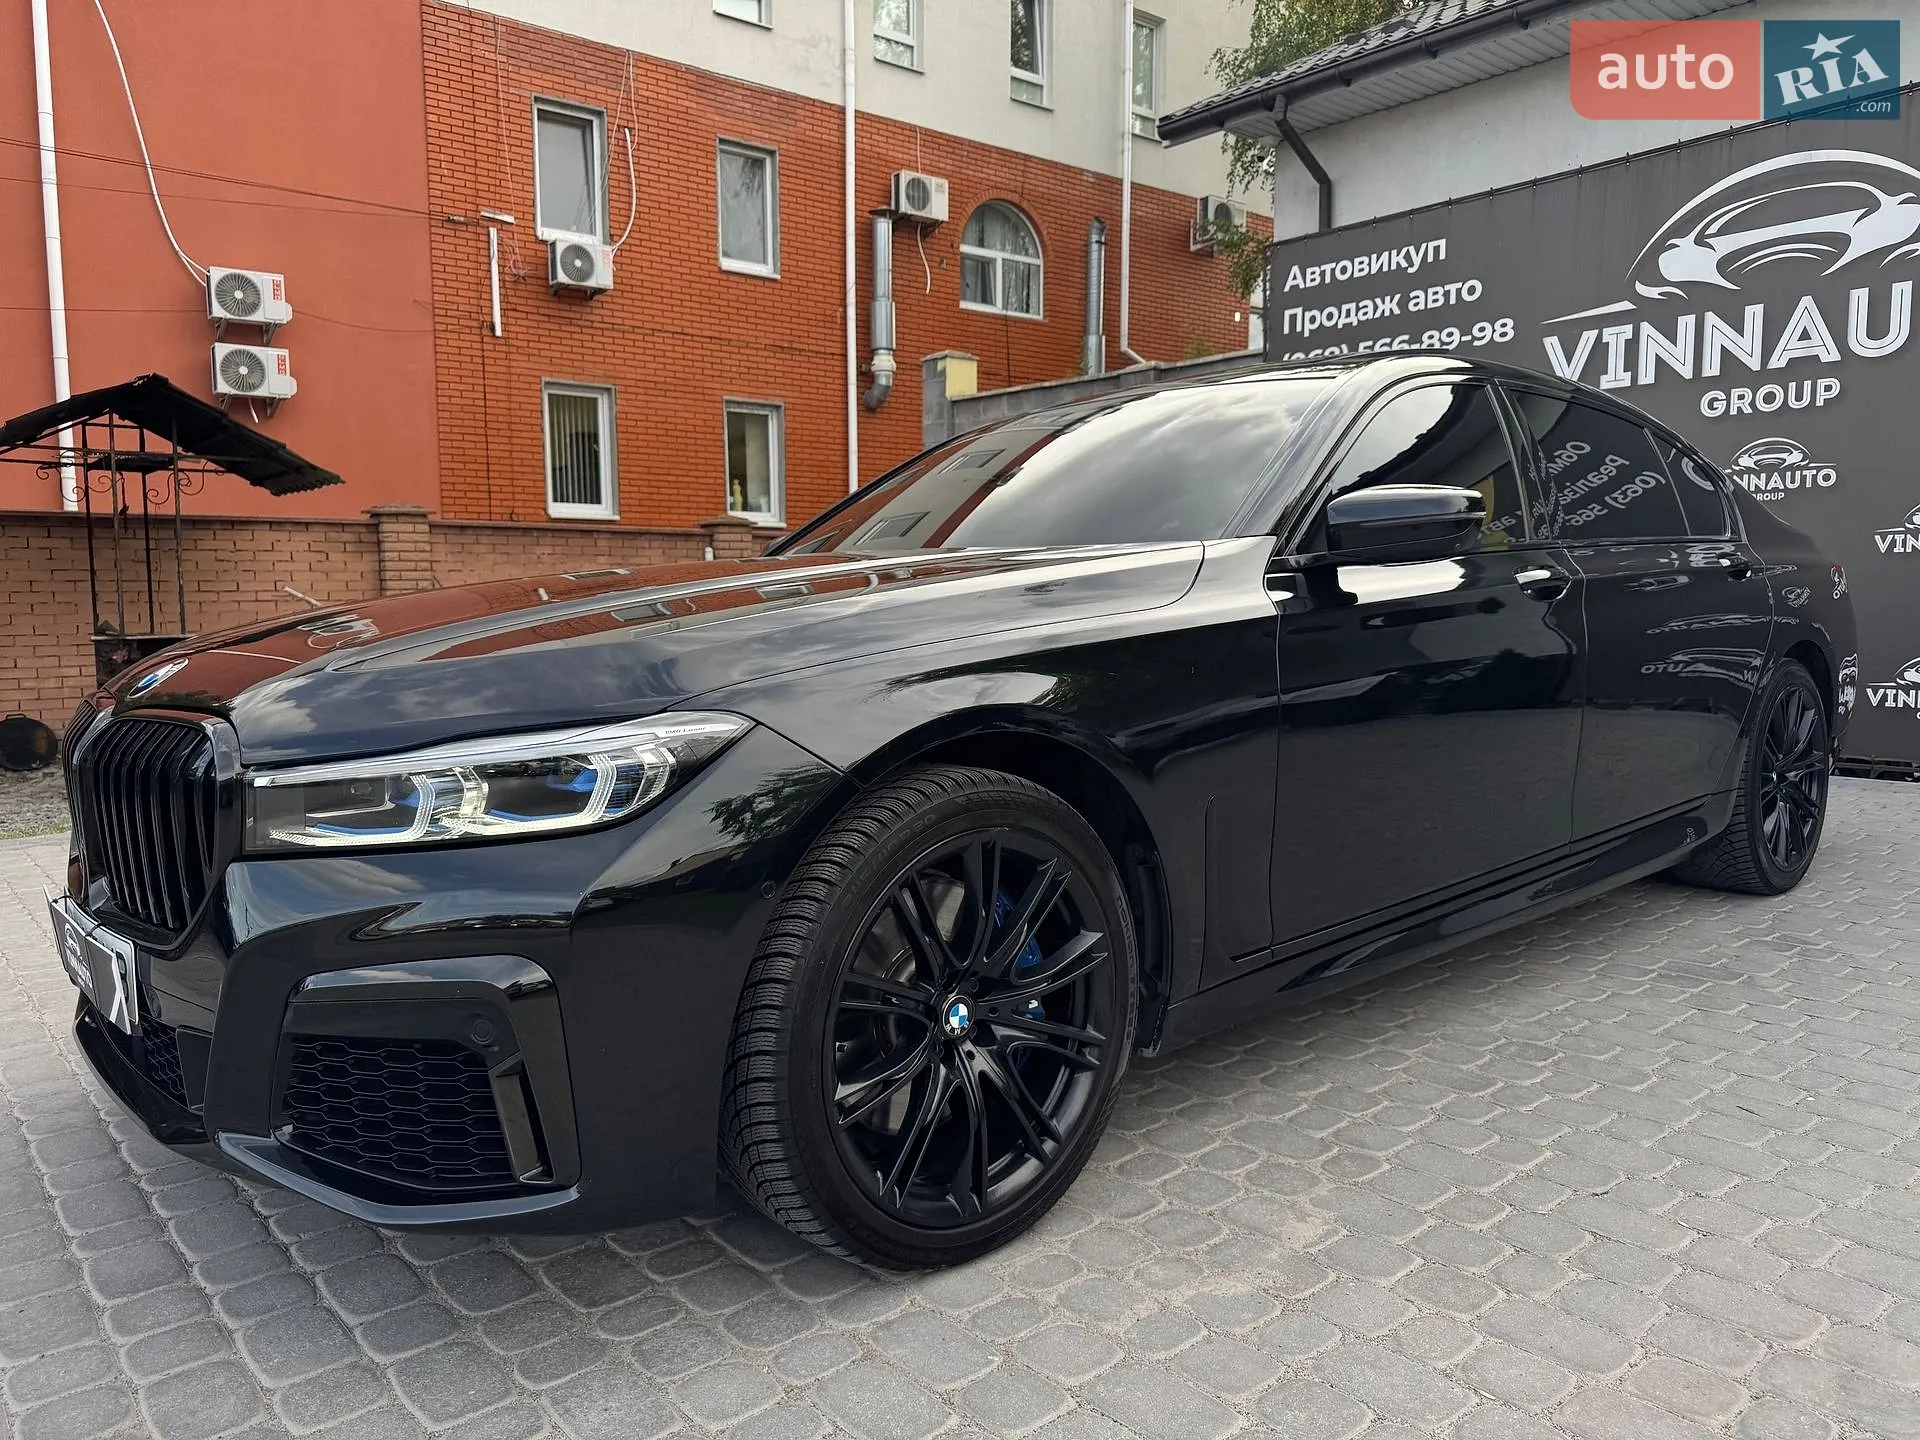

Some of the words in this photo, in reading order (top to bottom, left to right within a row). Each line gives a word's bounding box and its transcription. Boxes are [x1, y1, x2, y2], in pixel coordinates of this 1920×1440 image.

[1283, 238, 1447, 292] Автовикуп
[1283, 293, 1401, 337] Продаж
[1407, 279, 1483, 312] авто
[1542, 280, 1914, 390] VINNAU
[1700, 378, 1841, 418] GROUP
[1733, 468, 1837, 492] NNAUTO
[1866, 688, 1920, 708] VIN
